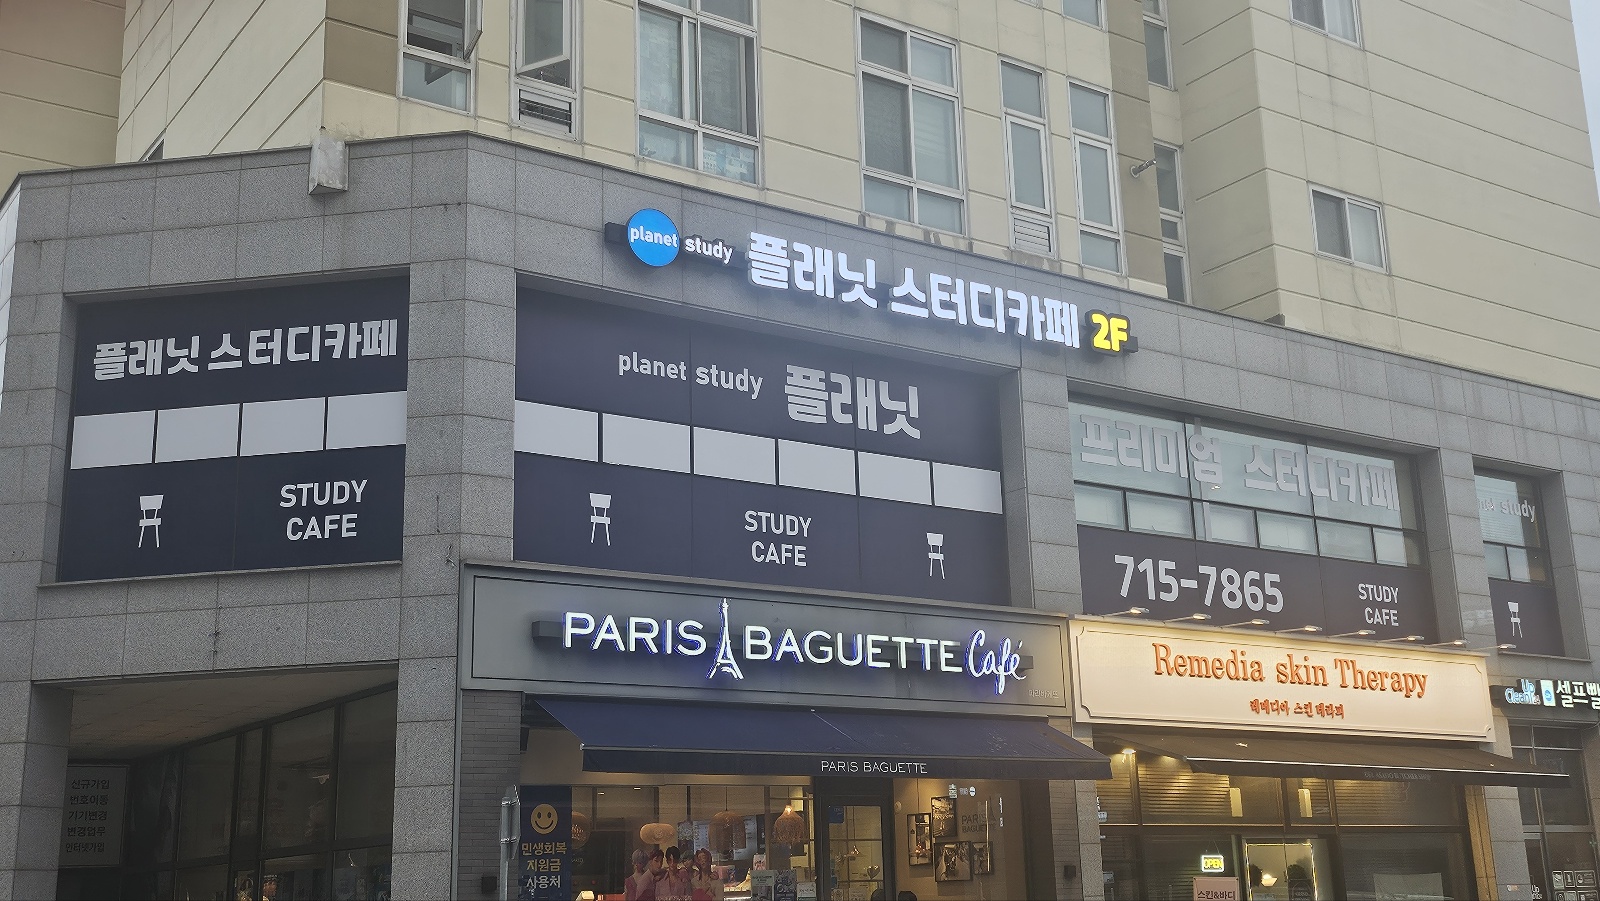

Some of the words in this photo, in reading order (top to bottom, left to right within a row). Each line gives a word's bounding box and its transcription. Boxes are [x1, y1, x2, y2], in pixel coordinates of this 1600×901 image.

[629, 224, 678, 248] planet
[685, 235, 733, 264] study
[748, 231, 877, 309] 플래닛
[890, 266, 1079, 350] 스터디카페
[1090, 313, 1128, 352] 2F
[93, 336, 200, 381] 플래닛
[207, 319, 398, 372] 스터디카페
[618, 350, 687, 382] planet
[695, 363, 763, 400] study
[784, 364, 921, 439] 플래닛
[1080, 413, 1222, 484] 프리미엄
[1244, 447, 1400, 513] 스터디카페
[280, 479, 368, 509] STUDY
[1501, 499, 1536, 523] study
[286, 513, 358, 541] CAFE
[744, 510, 812, 539] STUDY
[751, 540, 808, 568] CAFE
[1114, 554, 1284, 613] 715-7865
[1358, 583, 1400, 606] STUDY
[1364, 606, 1400, 627] CAFE
[562, 610, 707, 657] PARIS
[743, 625, 963, 674] BAGUETTE
[964, 629, 1027, 695] Café
[1152, 642, 1264, 682] Remedia
[1276, 653, 1329, 688] skin
[1334, 658, 1429, 699] Therapy
[1294, 701, 1314, 718] 스킨
[821, 760, 858, 772] PARIS
[863, 761, 928, 774] BAGUETTE
[71, 779, 110, 790] 신규가입
[70, 794, 109, 806] 번호이동
[68, 810, 108, 821] 기기변경
[67, 826, 106, 838] 변경업무
[65, 842, 105, 853] 인터넷가입
[521, 842, 567, 856] 민생회복
[526, 858, 562, 872] 지원금
[1203, 858, 1222, 868] OPEN
[526, 875, 561, 889] 사용처
[1197, 890, 1236, 900] 스킨&바디
